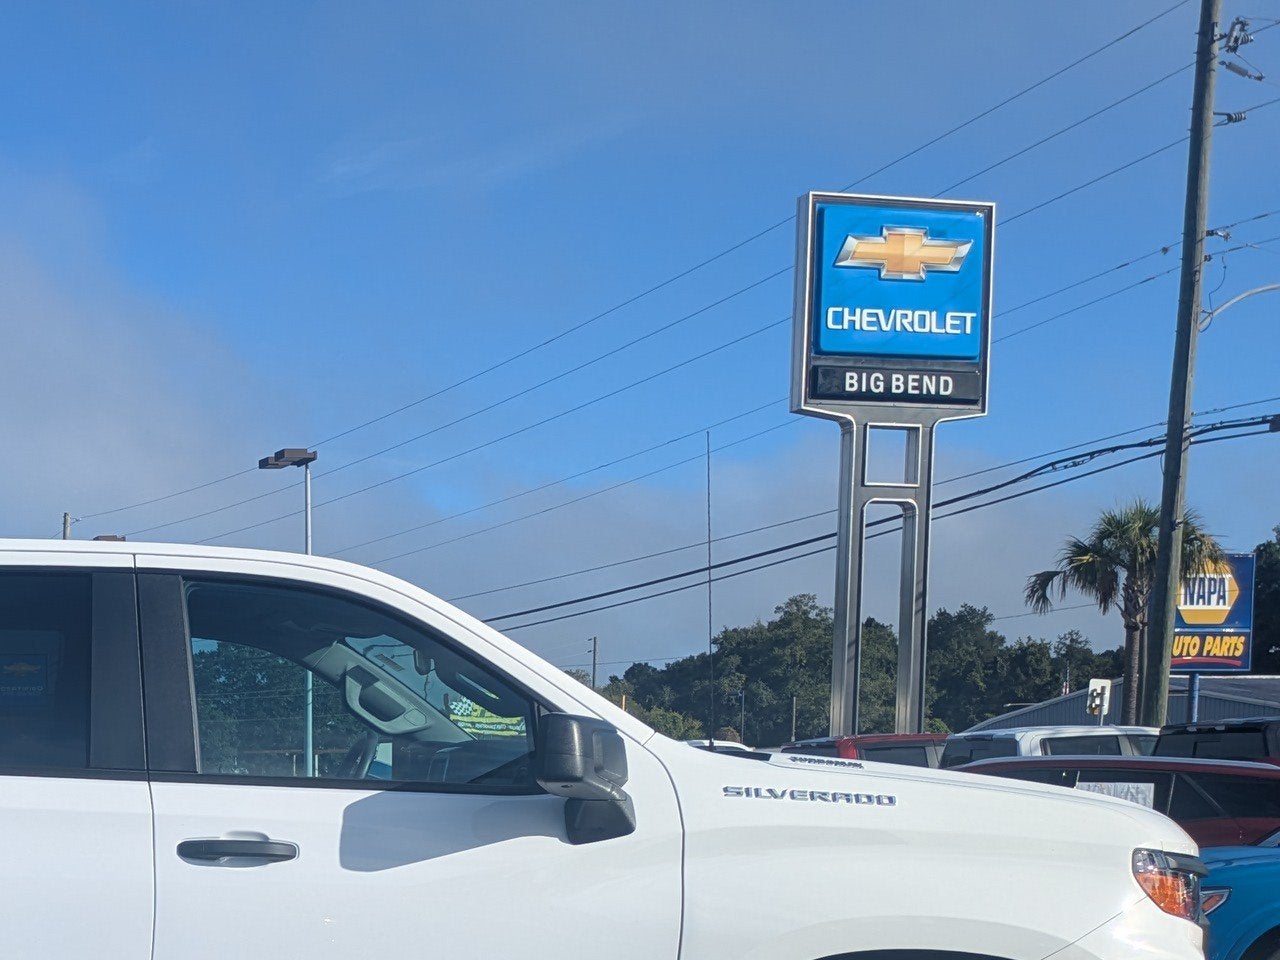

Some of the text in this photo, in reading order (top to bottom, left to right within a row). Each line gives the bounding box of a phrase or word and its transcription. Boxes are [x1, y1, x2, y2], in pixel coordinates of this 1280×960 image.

[826, 307, 976, 334] CHEVROLET
[845, 372, 953, 395] BIG BEND
[1183, 577, 1227, 606] NAPA
[1172, 635, 1245, 656] UTO PARTS
[722, 785, 897, 806] SILVERADO
